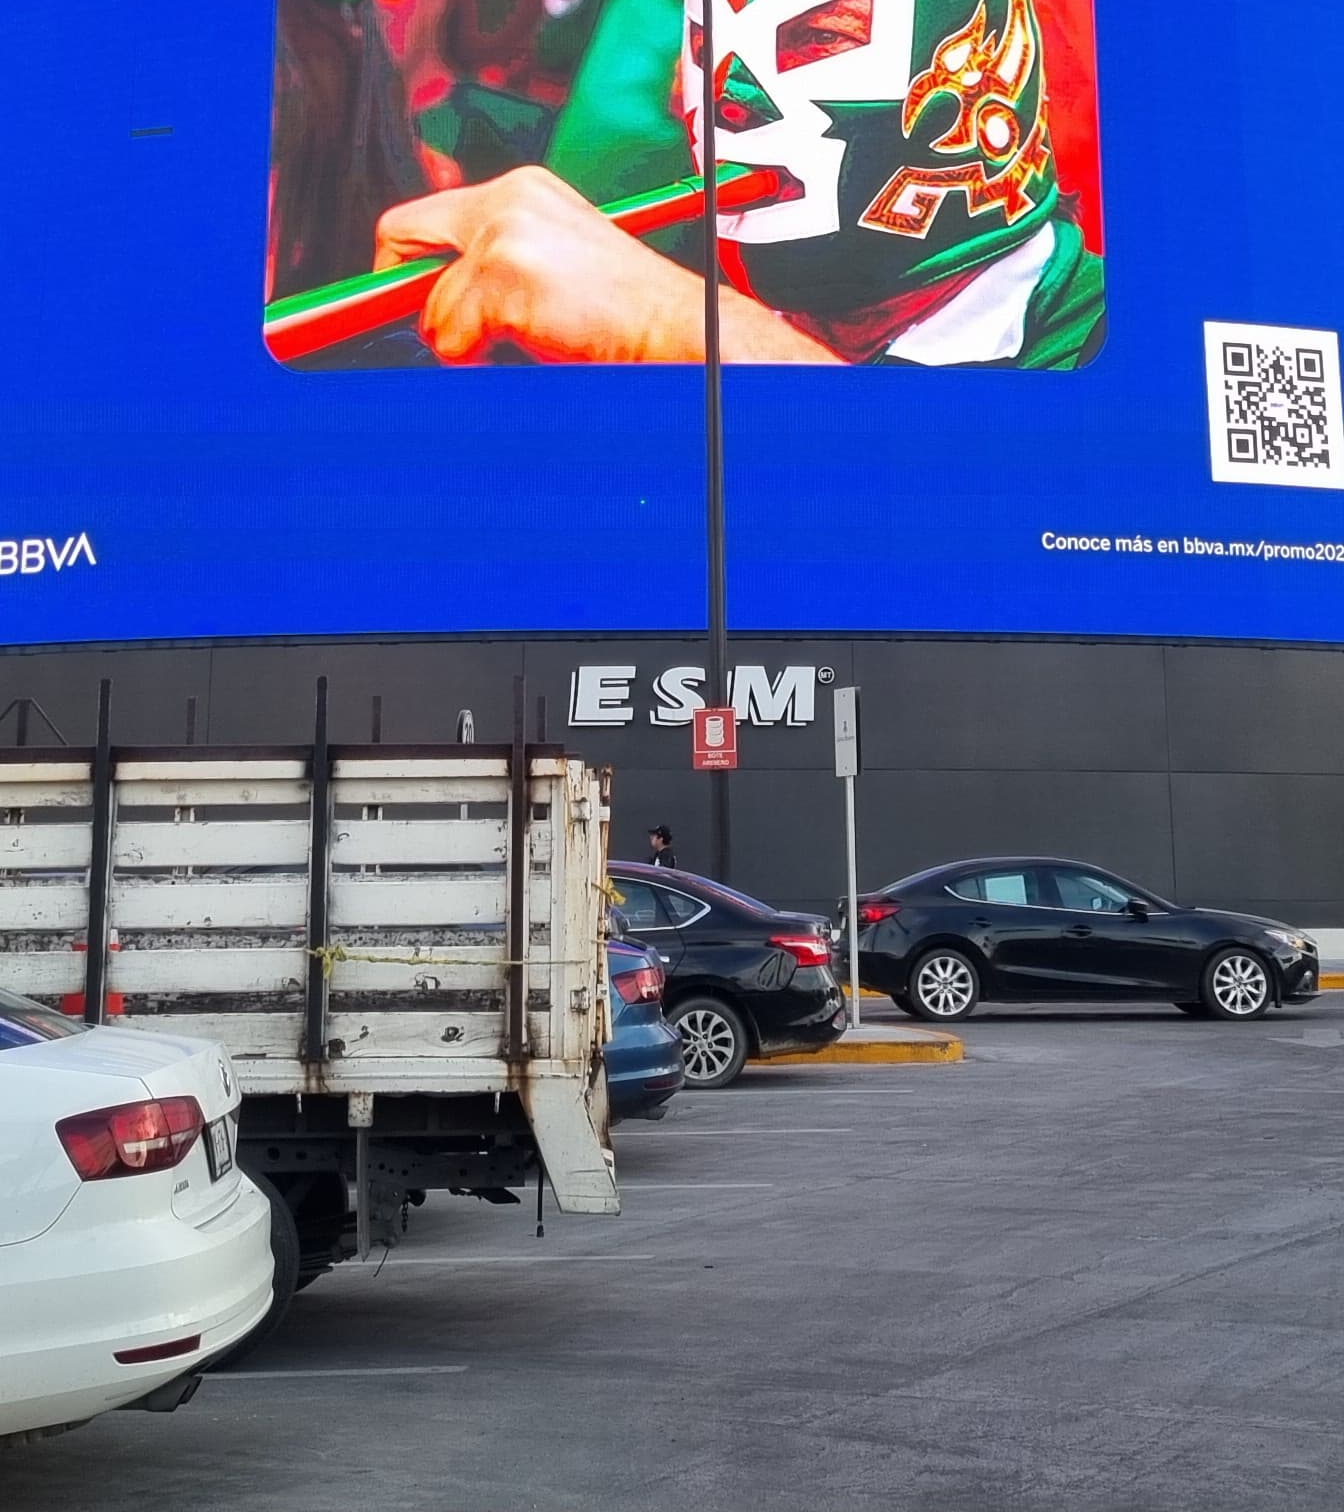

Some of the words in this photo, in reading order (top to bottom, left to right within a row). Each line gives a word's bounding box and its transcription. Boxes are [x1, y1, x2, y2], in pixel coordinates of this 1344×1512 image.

[1041, 532, 1112, 552] Conoce
[1115, 534, 1154, 553] más
[1157, 539, 1179, 554] en
[568, 665, 817, 727] ESM
